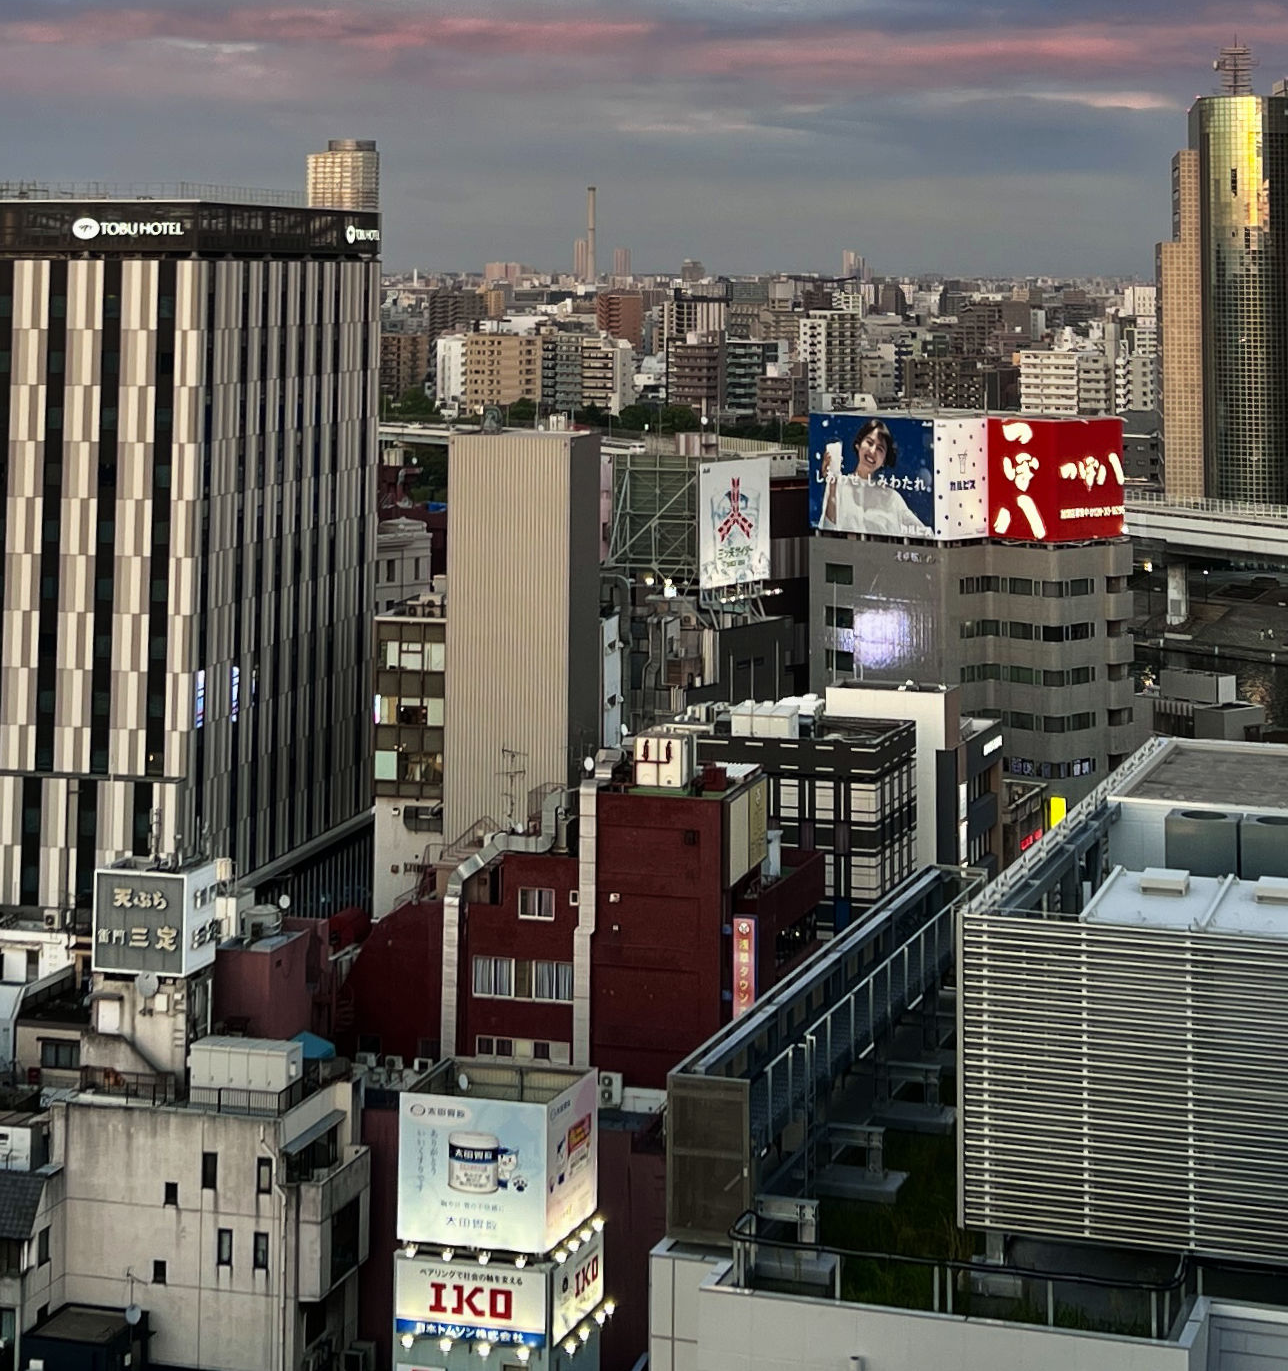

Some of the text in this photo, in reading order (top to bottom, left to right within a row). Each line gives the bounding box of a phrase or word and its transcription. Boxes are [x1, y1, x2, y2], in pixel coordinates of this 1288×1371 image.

[100, 222, 184, 235] TOBU HOTEL
[113, 888, 168, 909] 天ぷら
[575, 1254, 599, 1298] IKO
[429, 1282, 513, 1320] IKO
